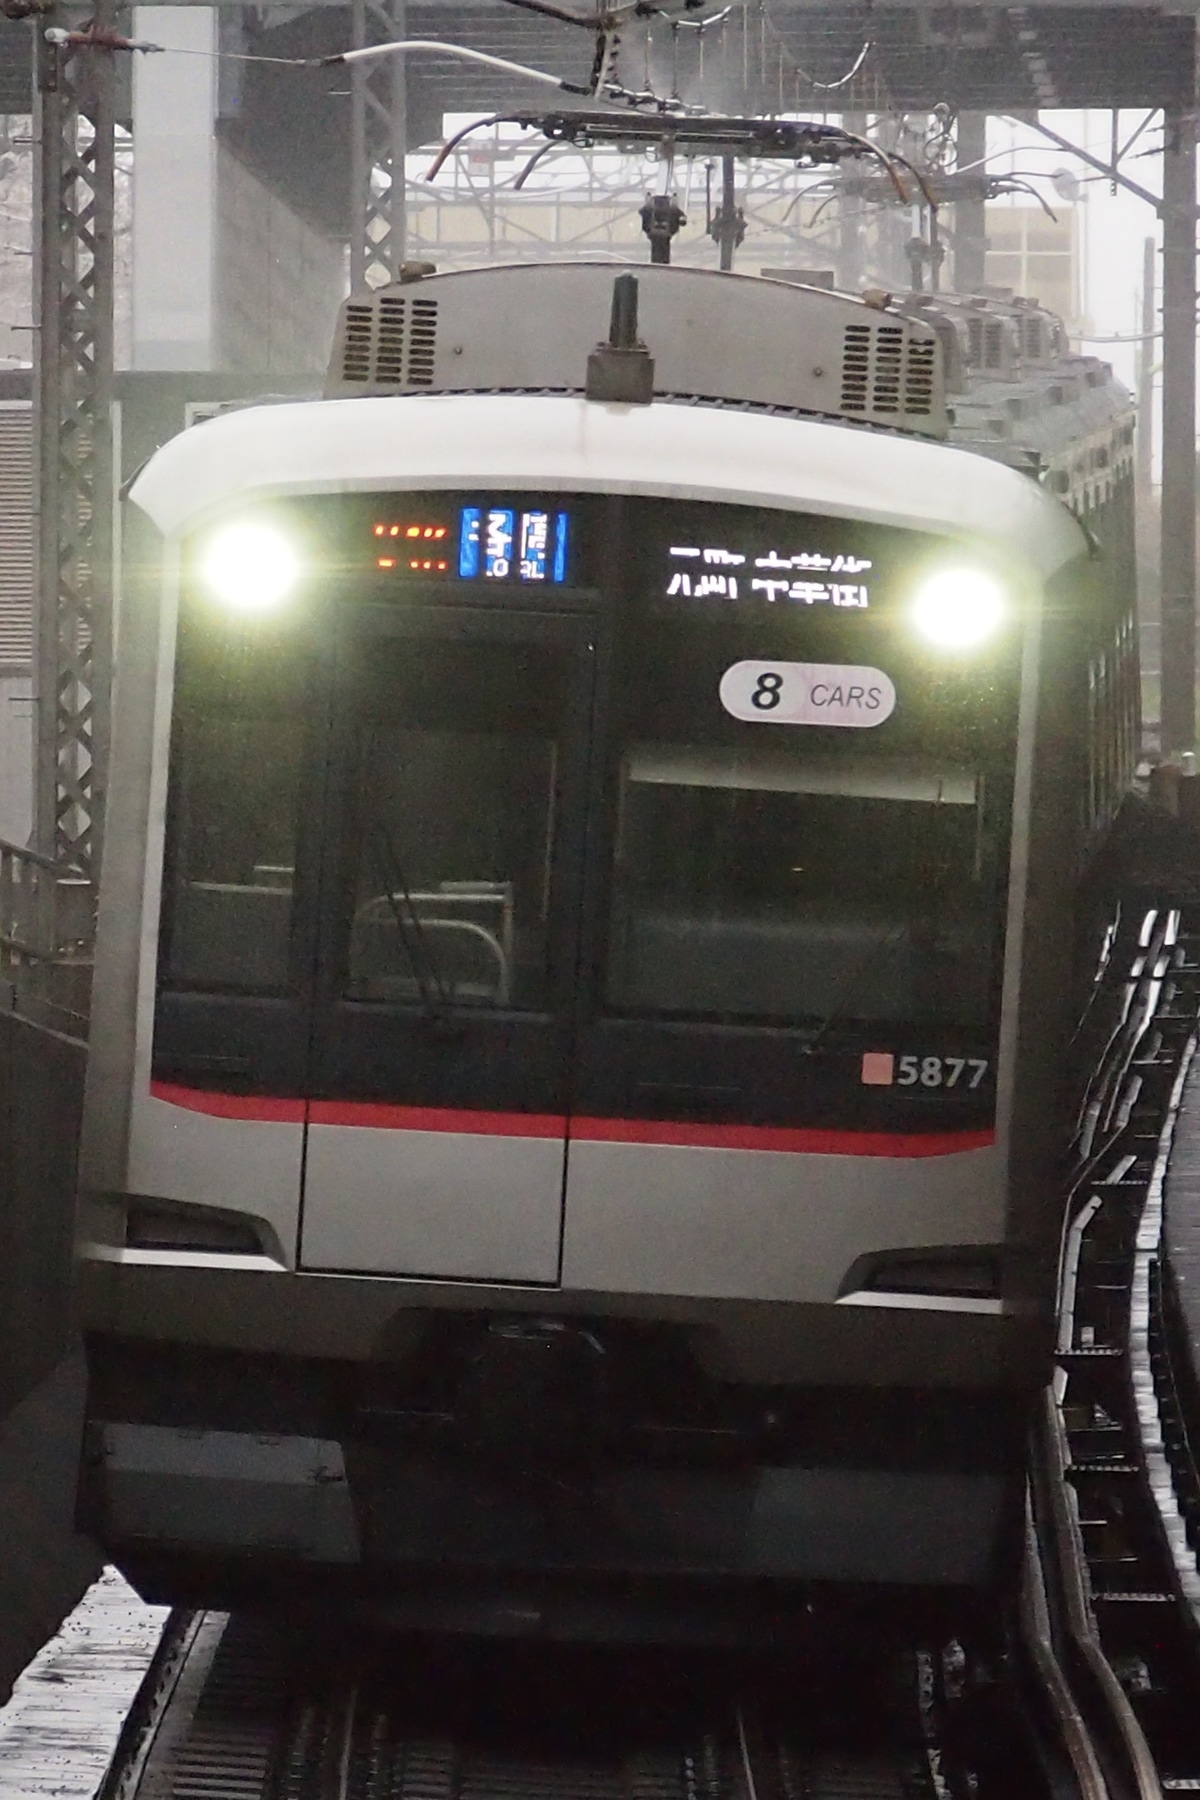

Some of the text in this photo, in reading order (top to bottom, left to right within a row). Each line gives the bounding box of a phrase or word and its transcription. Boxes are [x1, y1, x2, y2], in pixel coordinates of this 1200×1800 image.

[751, 672, 882, 710] 8 CARS
[897, 1055, 989, 1089] 5877
